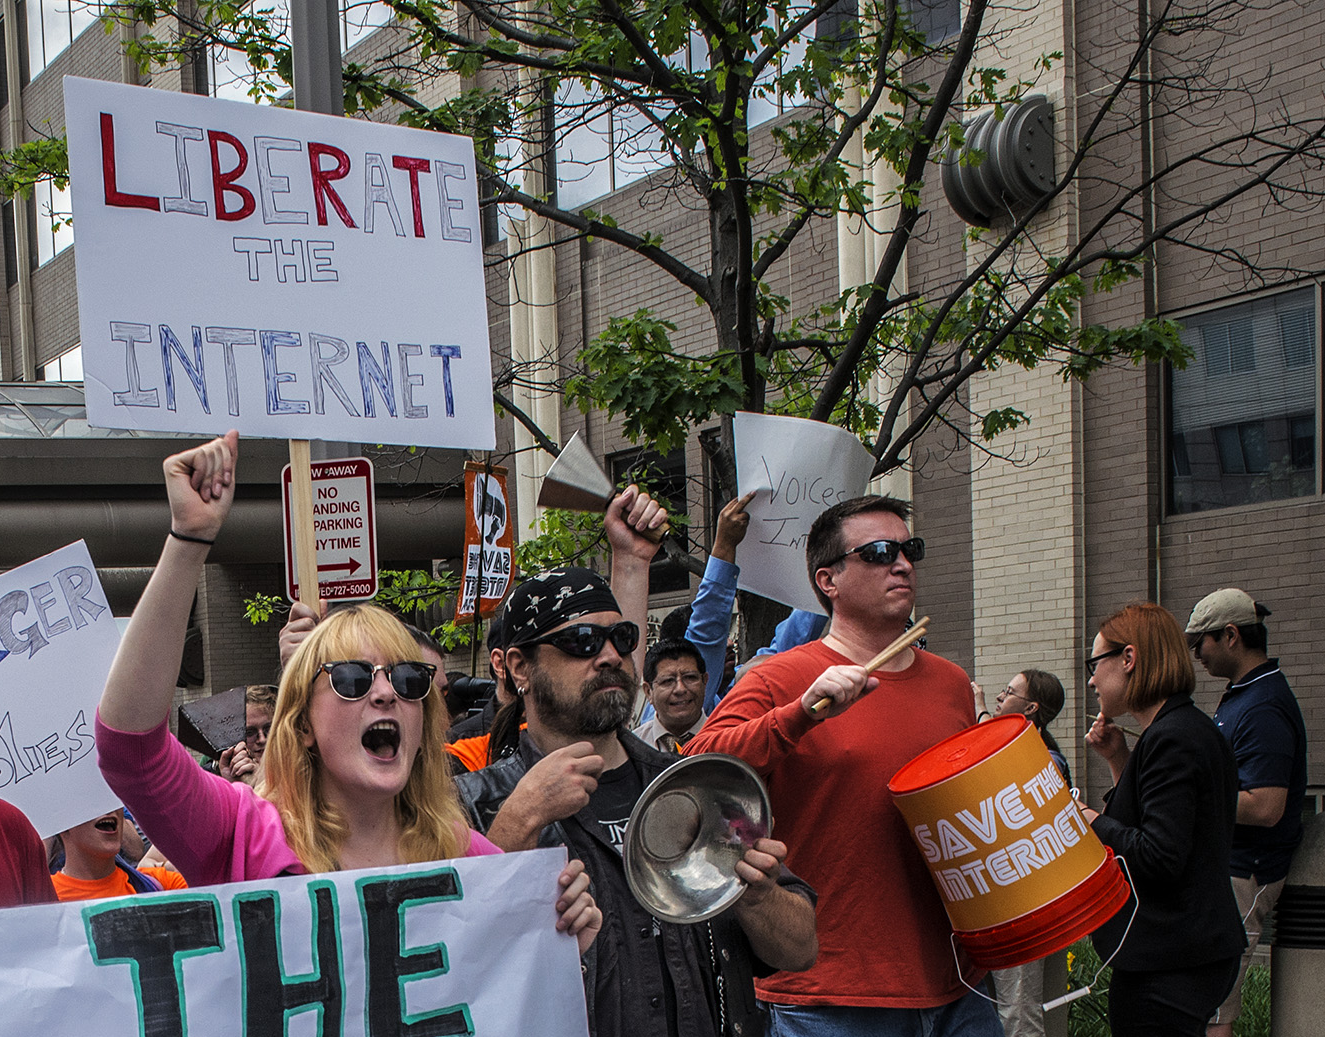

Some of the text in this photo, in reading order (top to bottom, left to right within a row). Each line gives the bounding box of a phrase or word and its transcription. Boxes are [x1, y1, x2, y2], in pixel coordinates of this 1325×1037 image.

[99, 111, 472, 243] LIBERATE
[233, 237, 338, 283] THE
[109, 321, 462, 419] INTERNET
[313, 501, 360, 515] ANDING
[314, 517, 363, 532] PARKING
[318, 487, 338, 499] NO
[914, 760, 1065, 863] SAVE THE
[934, 799, 1088, 902] INTERNET
